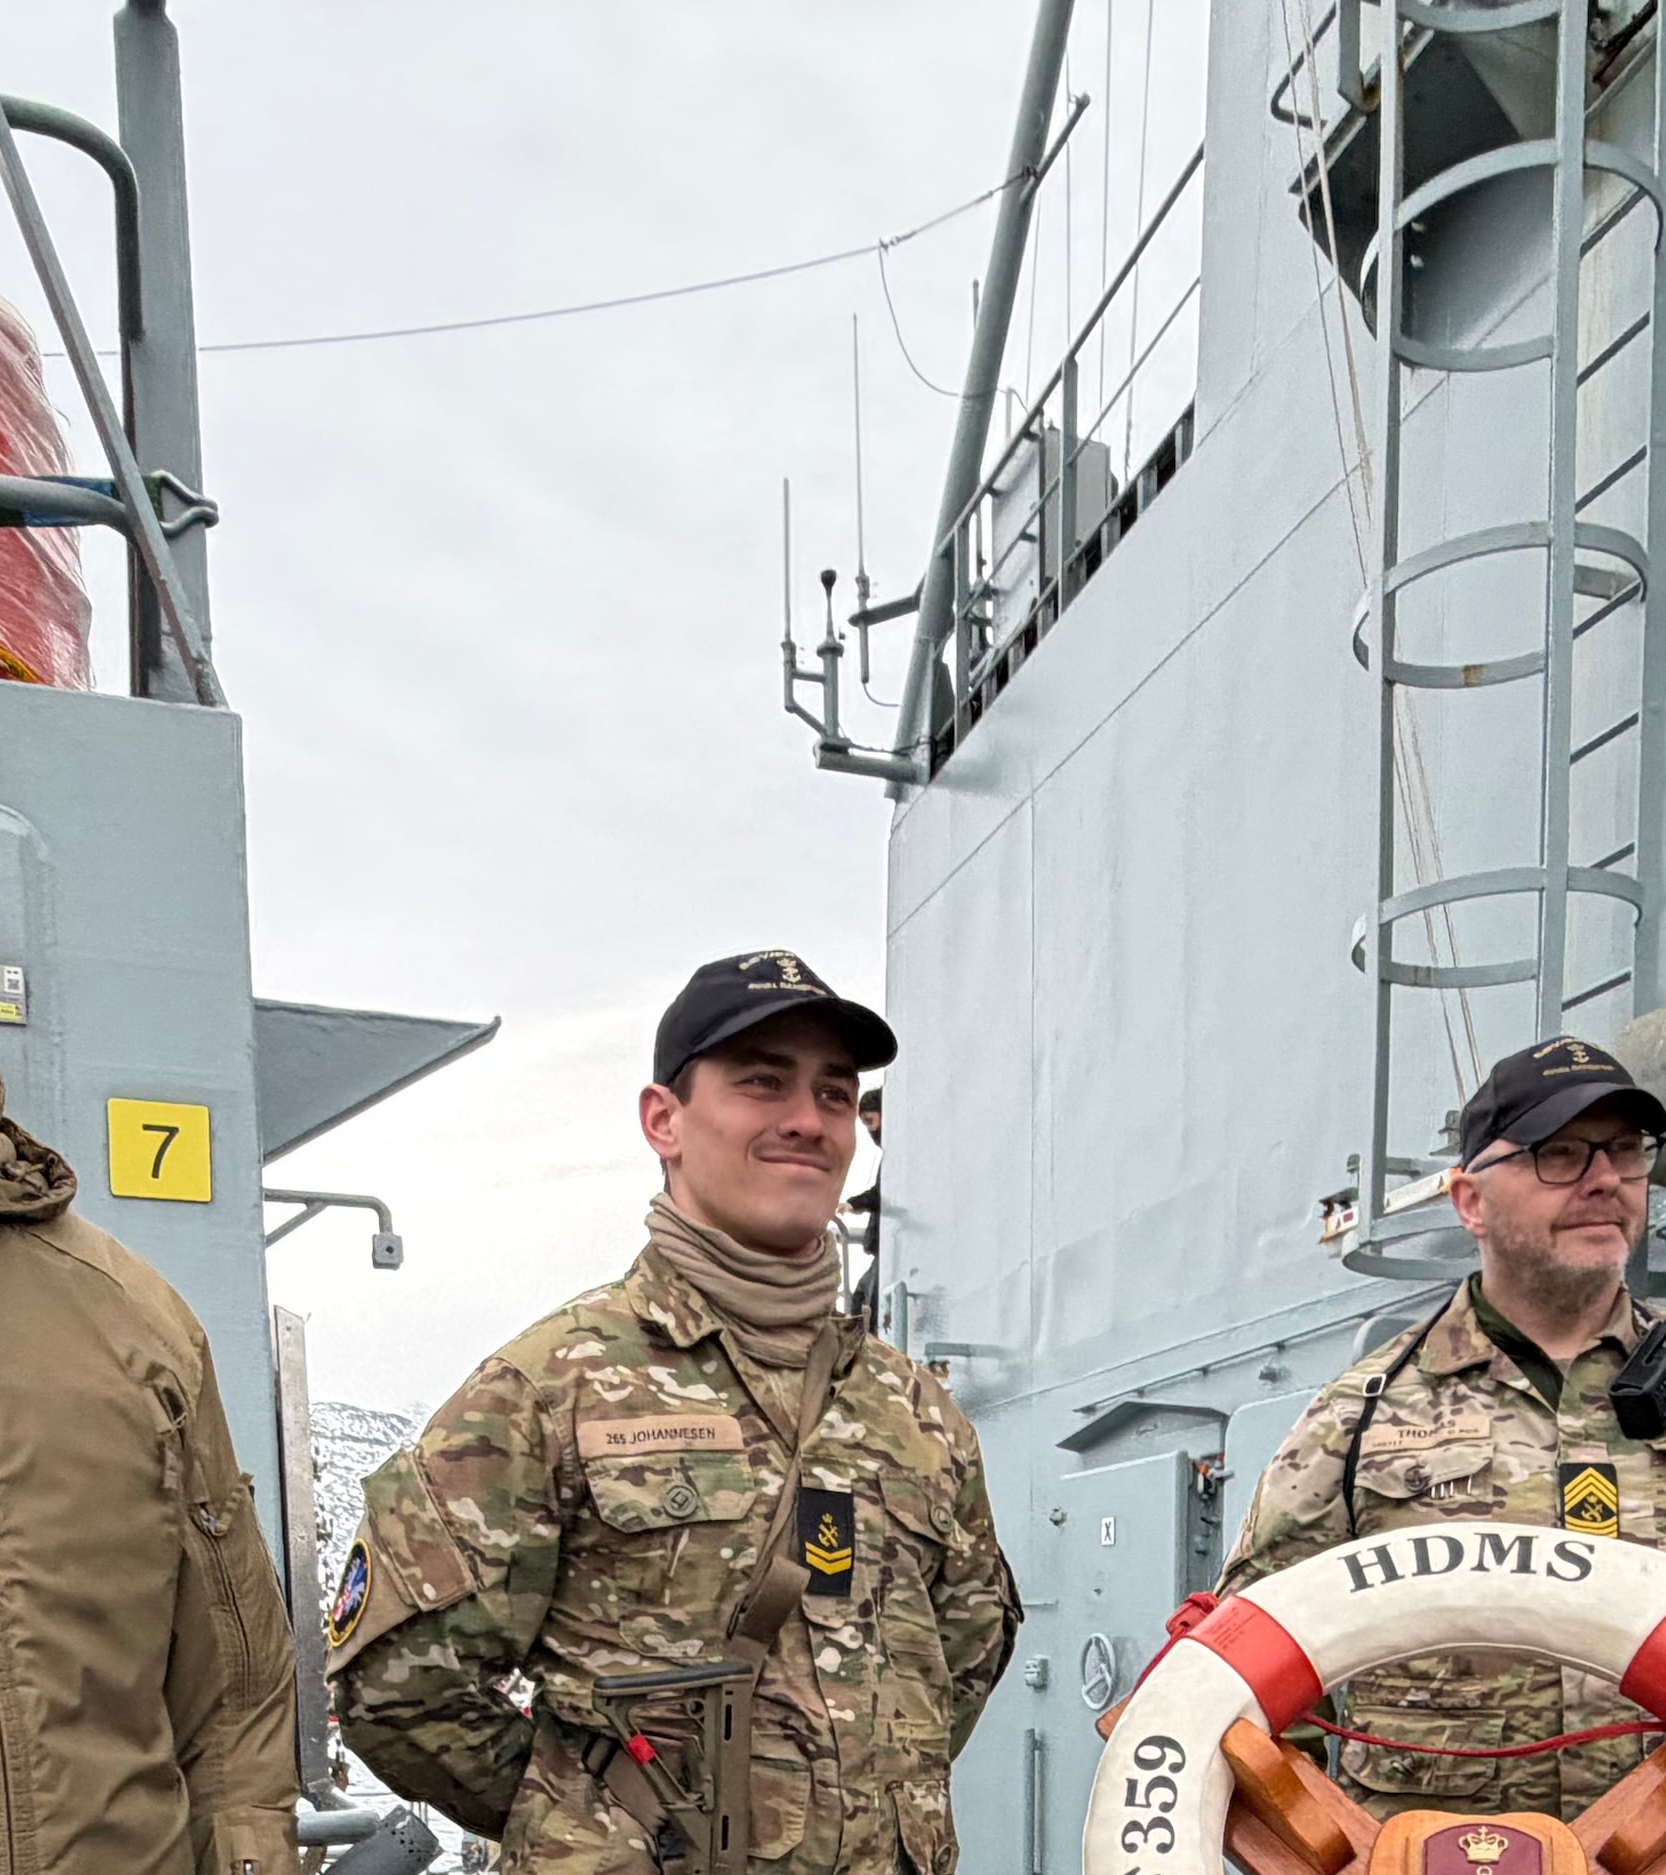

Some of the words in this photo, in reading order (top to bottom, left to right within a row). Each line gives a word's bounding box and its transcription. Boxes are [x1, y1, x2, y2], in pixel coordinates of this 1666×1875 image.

[142, 1123, 180, 1179] 7
[629, 1427, 716, 1445] JOHANNESEN
[1104, 1521, 1112, 1541] X
[1337, 1532, 1599, 1593] HDMS
[1121, 1734, 1188, 1856] 359
